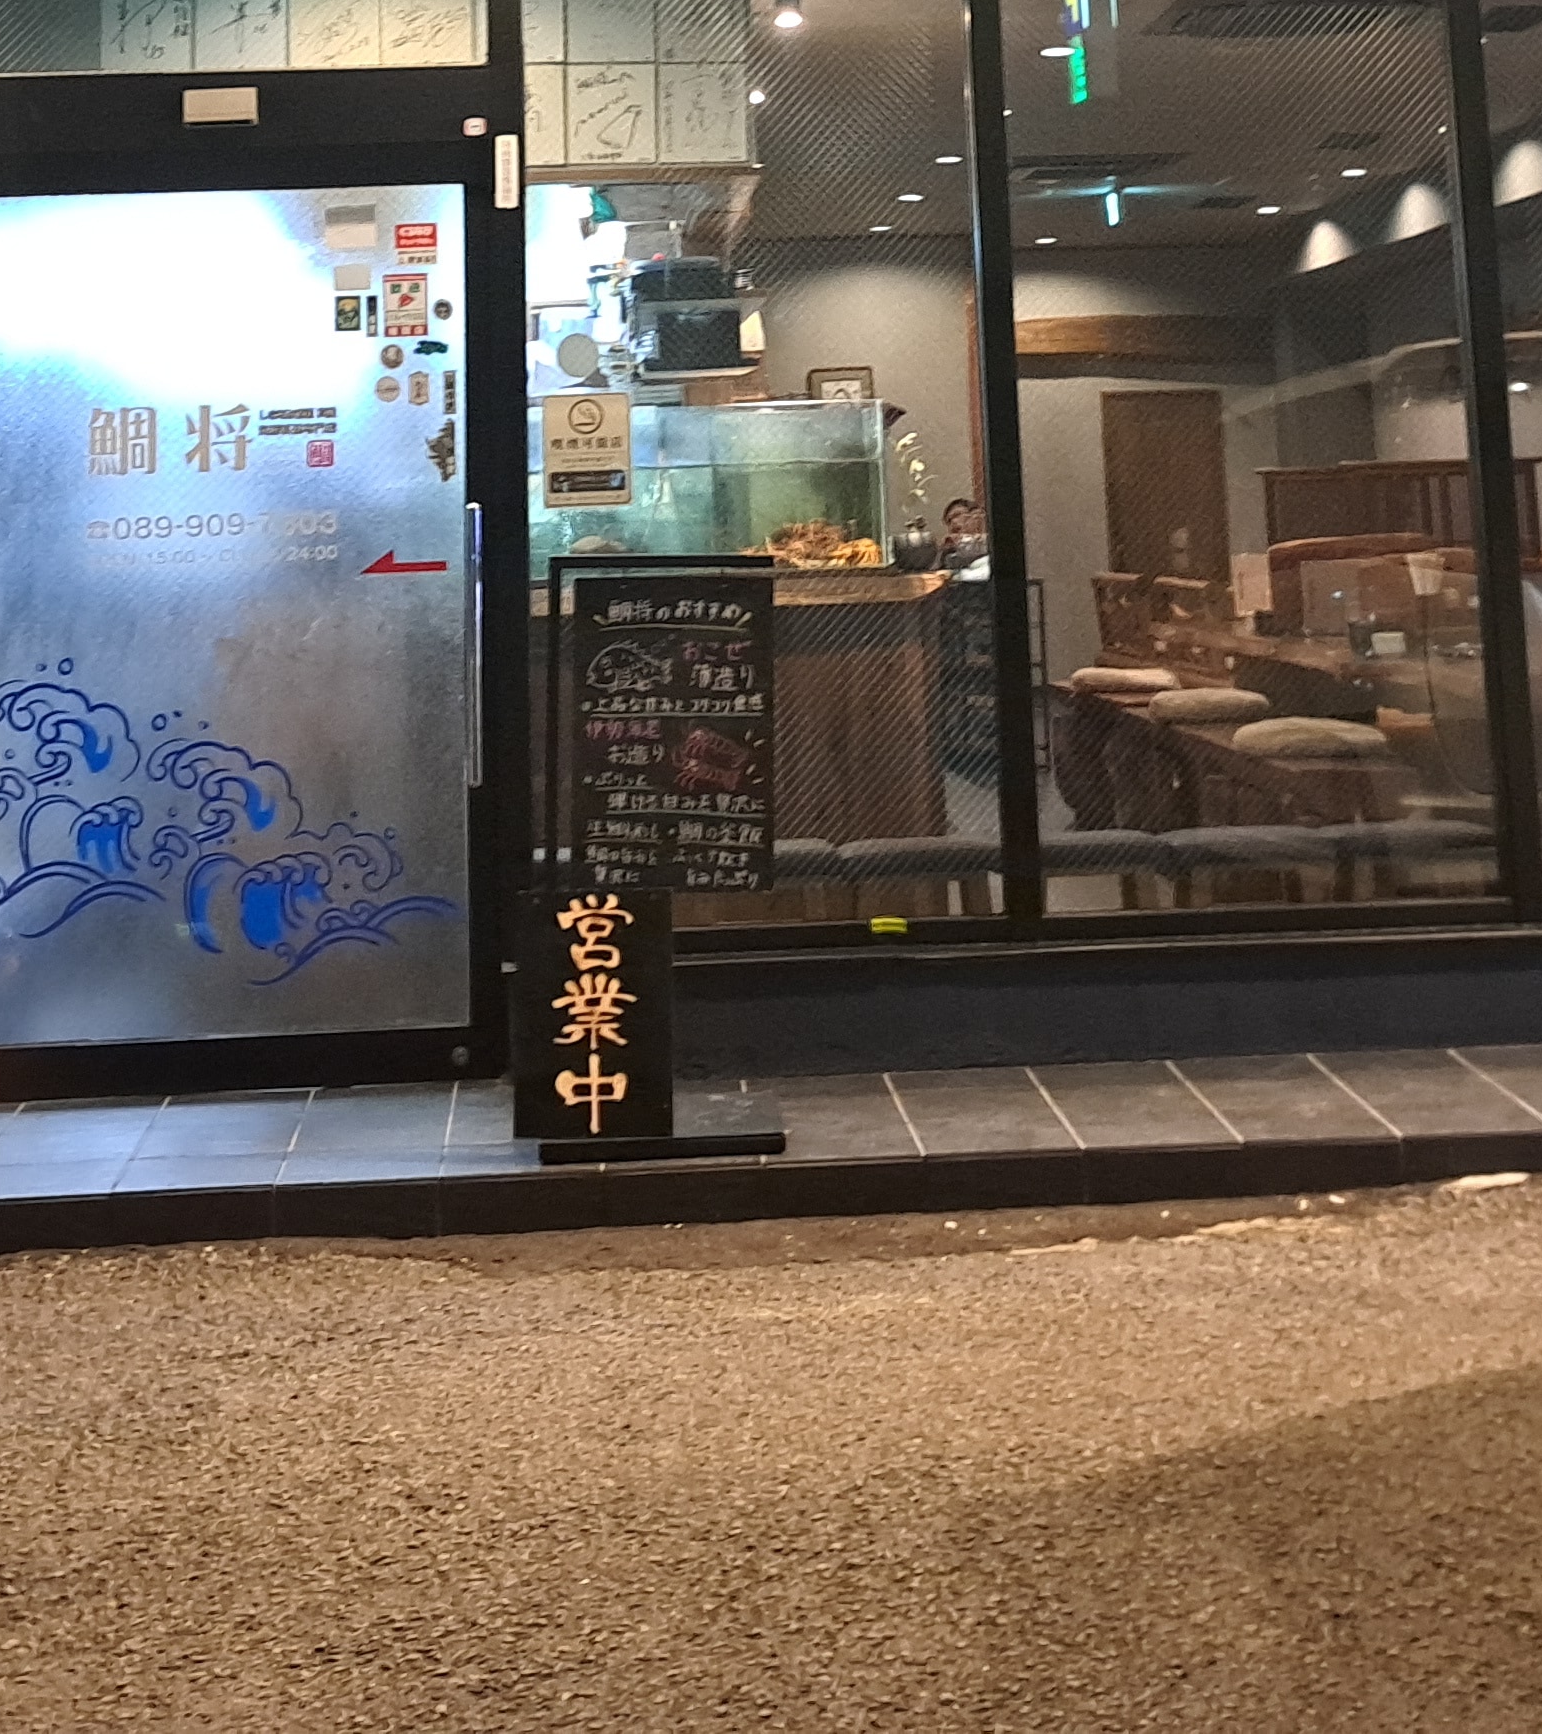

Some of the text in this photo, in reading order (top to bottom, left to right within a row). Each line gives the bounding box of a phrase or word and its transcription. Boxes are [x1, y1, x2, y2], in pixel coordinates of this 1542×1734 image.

[87, 404, 253, 475] 鯛将
[552, 892, 639, 1135] 営業中
